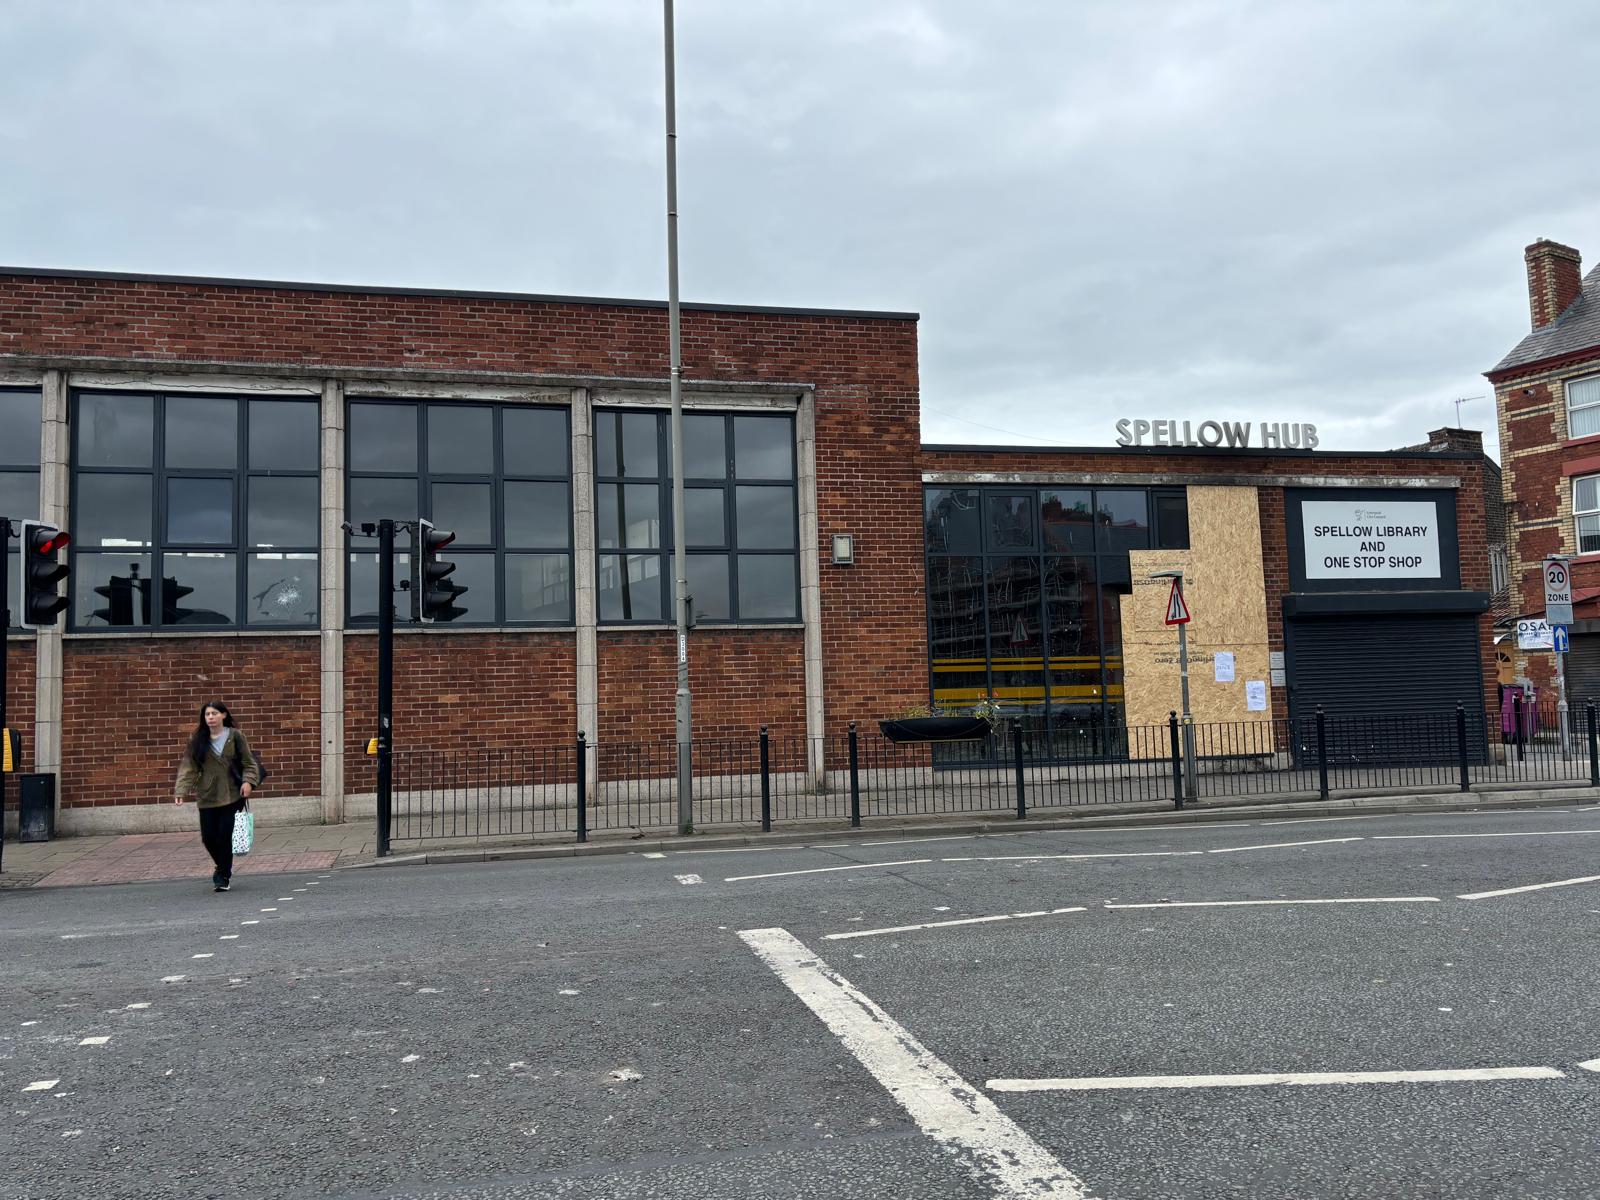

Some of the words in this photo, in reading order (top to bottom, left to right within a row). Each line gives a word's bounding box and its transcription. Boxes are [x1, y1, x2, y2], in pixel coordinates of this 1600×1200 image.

[1115, 418, 1251, 448] SPELLOW
[1260, 422, 1320, 449] HUB
[1314, 526, 1373, 537] SPELLOW
[1376, 526, 1428, 537] LIBRARY
[1360, 541, 1385, 552] AND
[1324, 556, 1351, 568] ONE
[1353, 556, 1385, 568] STOP
[1388, 556, 1422, 568] SHOP
[1548, 571, 1565, 584] 20
[1547, 593, 1569, 602] ZONE
